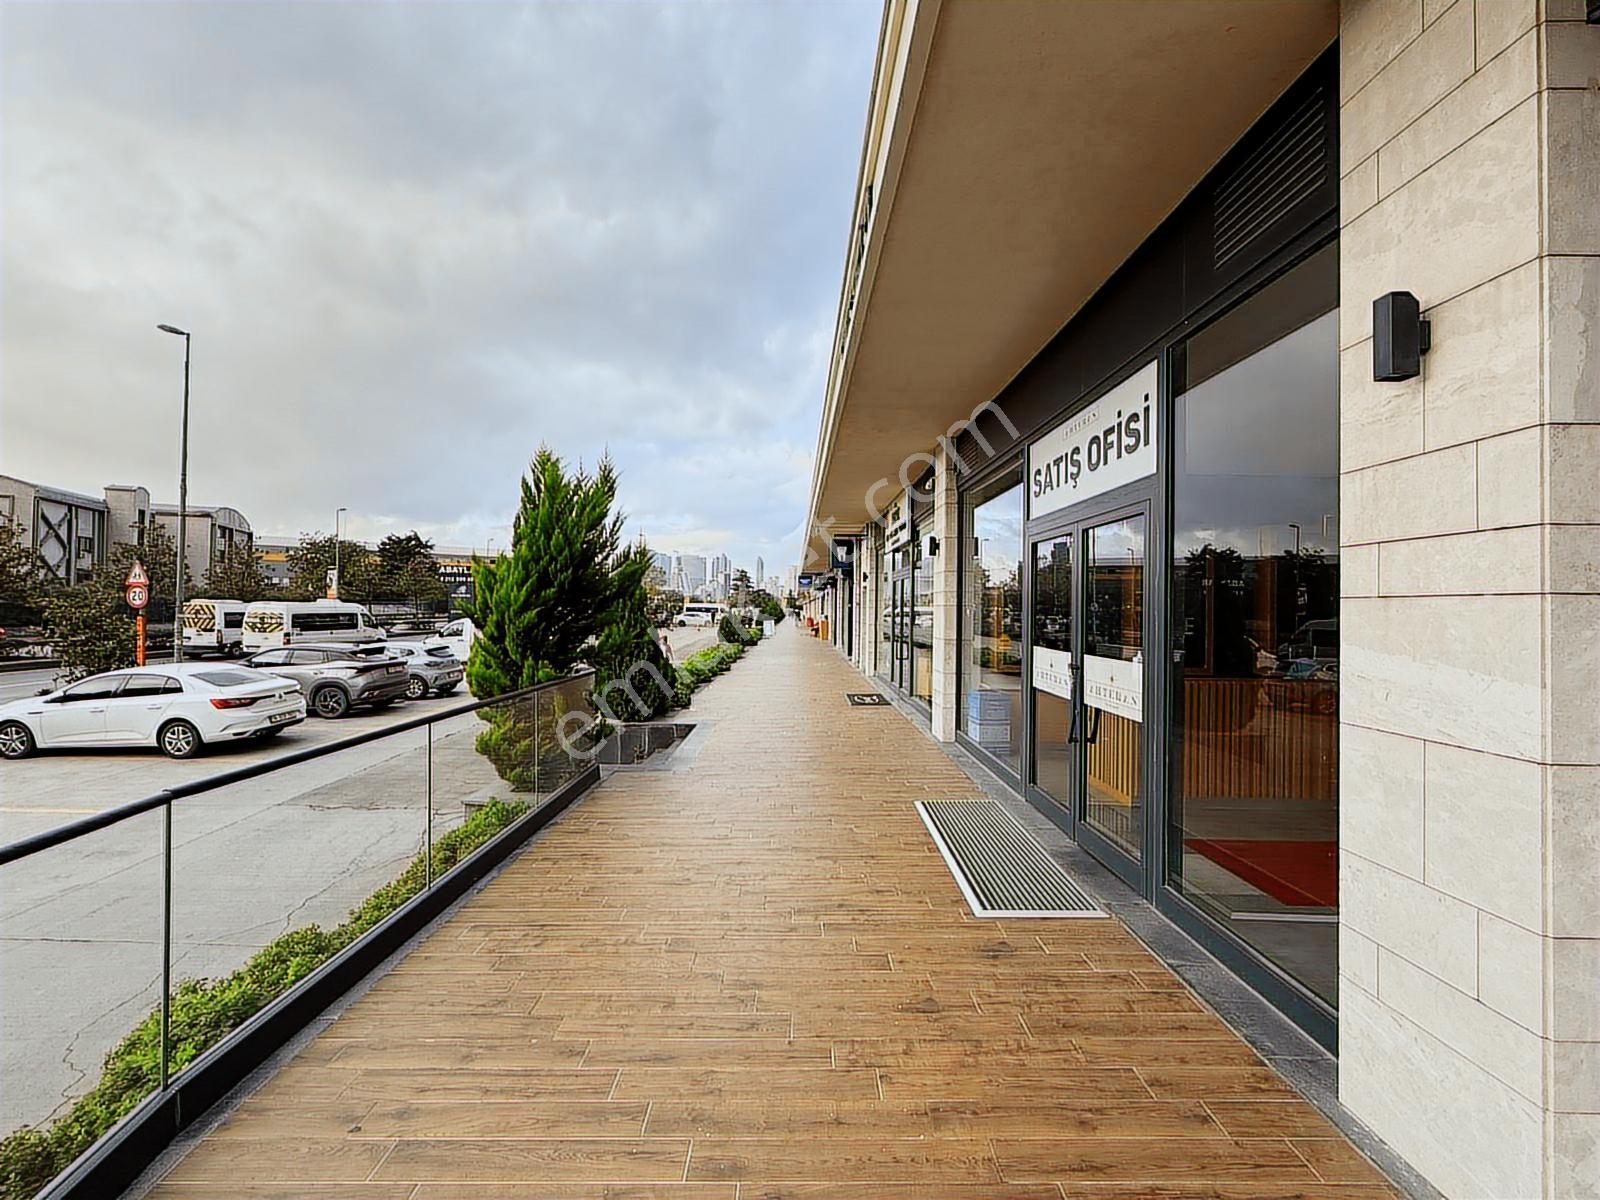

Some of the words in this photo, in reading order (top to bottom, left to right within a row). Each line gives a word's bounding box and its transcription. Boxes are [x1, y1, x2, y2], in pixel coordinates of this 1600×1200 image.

[1033, 446, 1081, 498] SATIŞ
[1087, 392, 1150, 472] OFİSİ
[132, 591, 143, 601] 20
